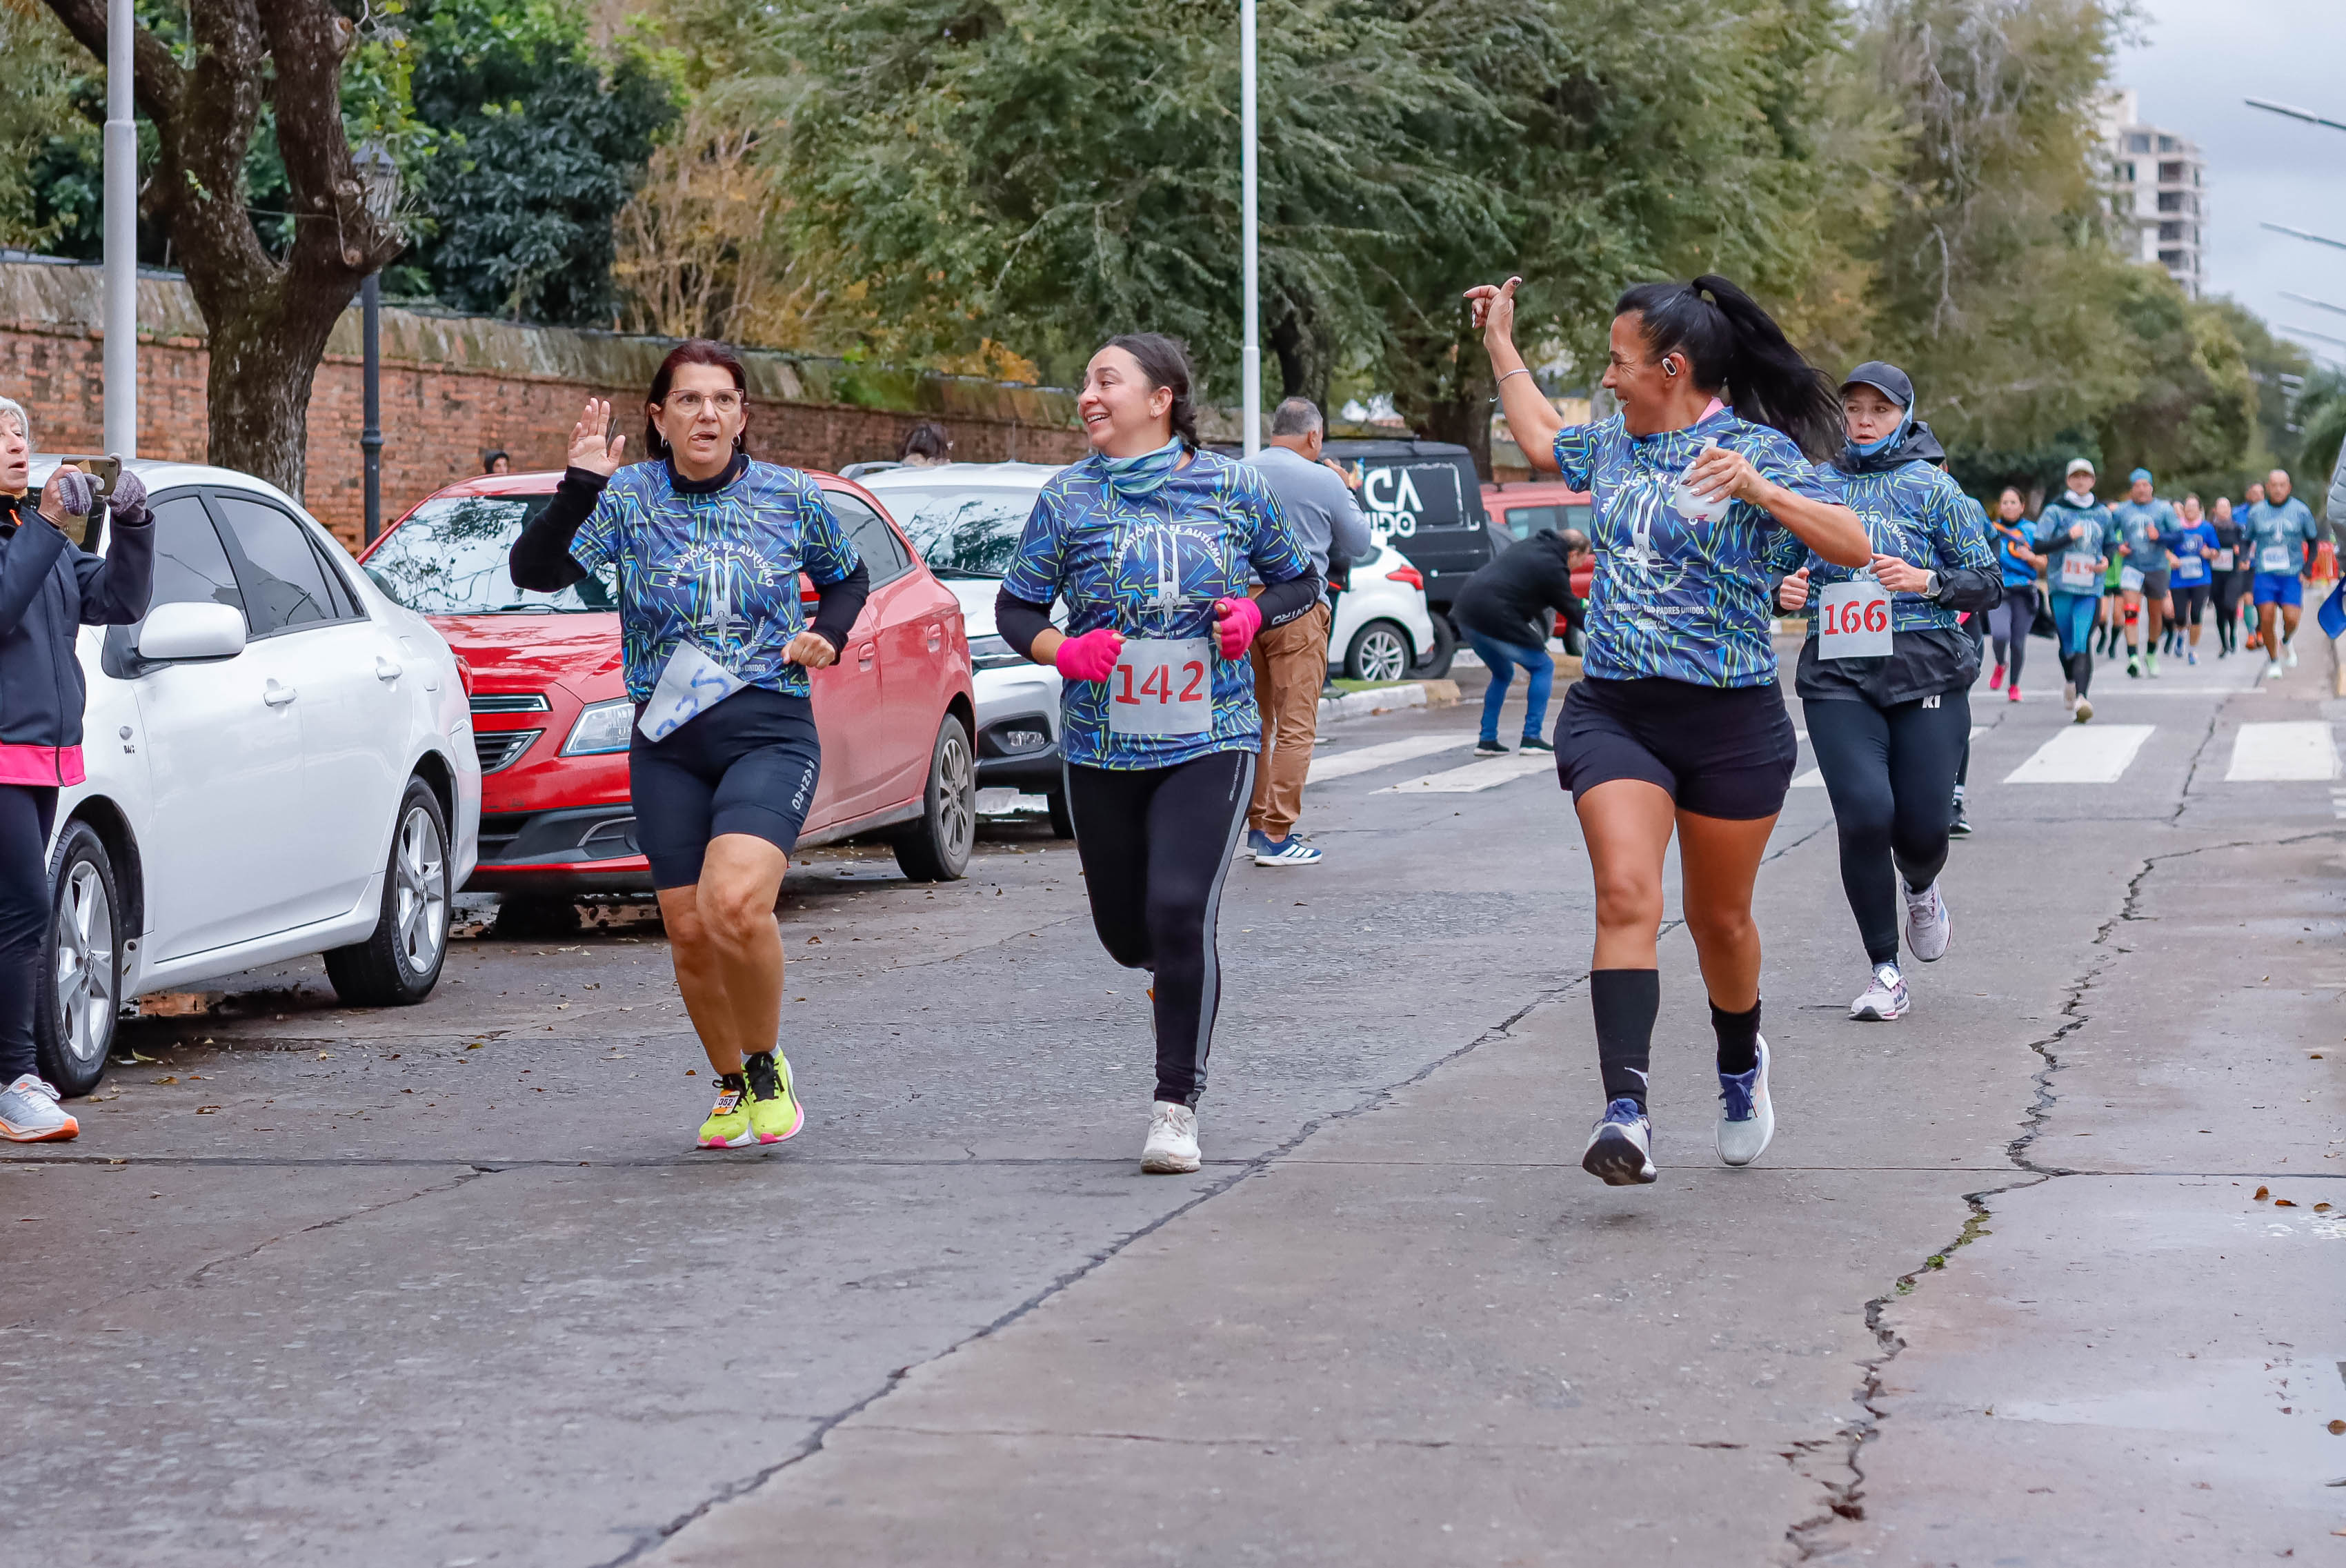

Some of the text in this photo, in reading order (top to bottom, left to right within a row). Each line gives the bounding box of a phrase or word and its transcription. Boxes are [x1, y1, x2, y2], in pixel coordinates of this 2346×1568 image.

[1169, 524, 1182, 533] EL
[1184, 527, 1222, 568] AUTISMO
[1880, 518, 1908, 552] AUTISMO
[712, 541, 719, 551] X
[722, 541, 735, 551] EL
[737, 544, 774, 587] AUTISMO
[754, 615, 766, 640] POSITIVA
[1656, 606, 1680, 615] PADRES
[1681, 606, 1704, 615] UNIDOS
[1825, 599, 1887, 635] 166
[745, 664, 766, 673] UNIDOS
[1115, 660, 1204, 705] 142
